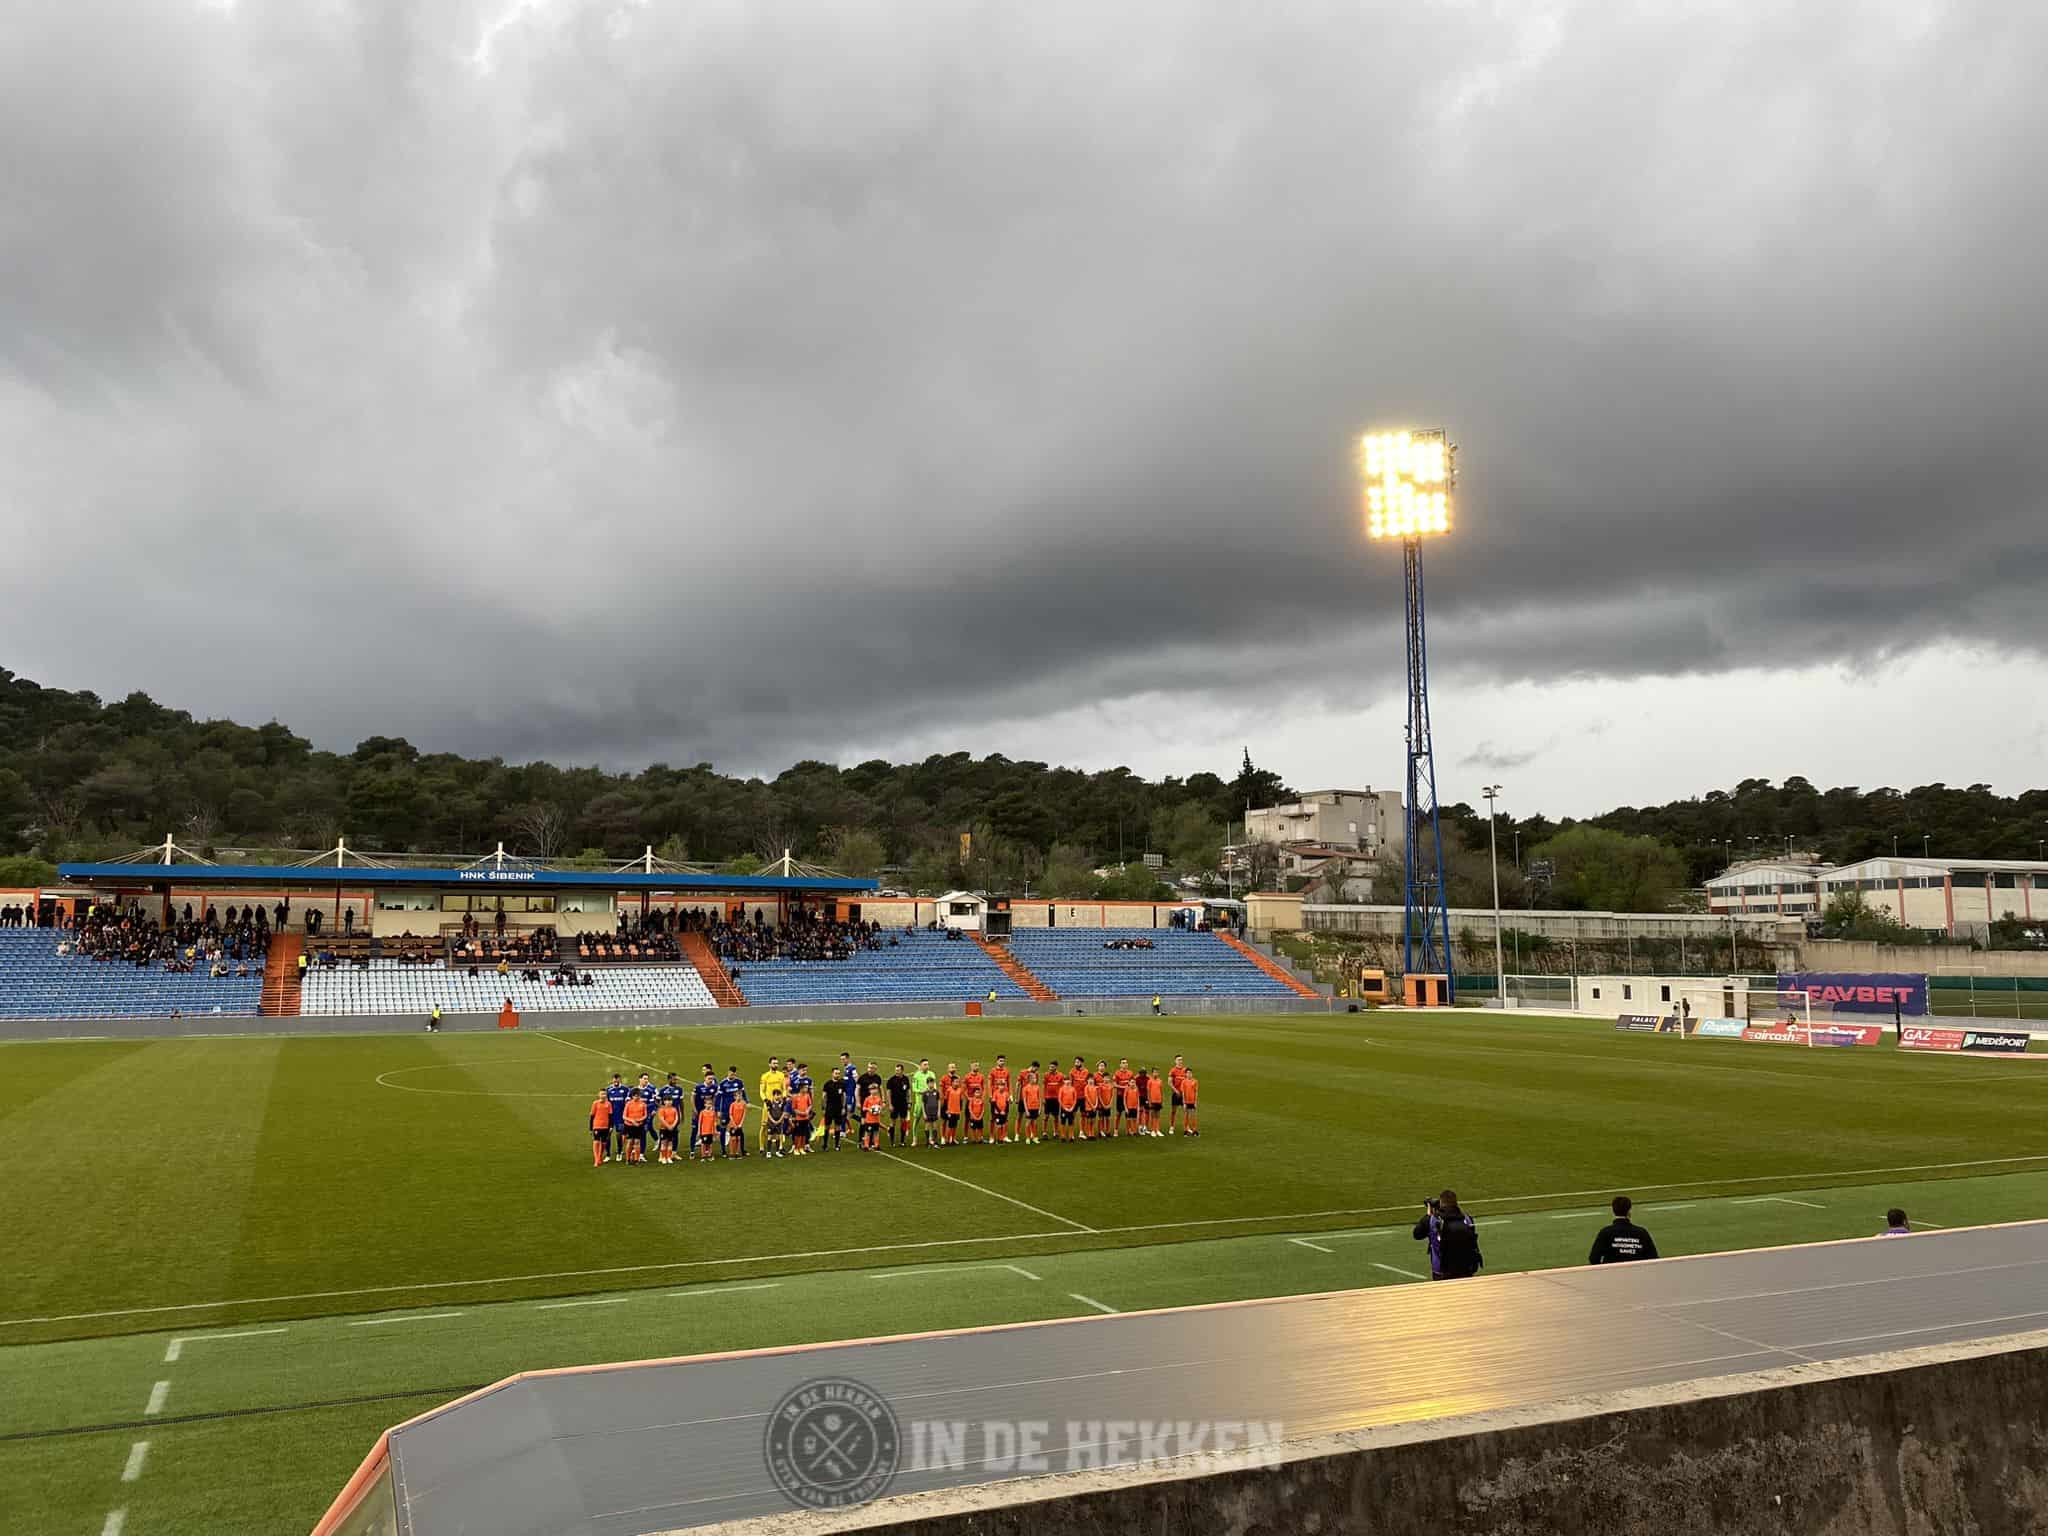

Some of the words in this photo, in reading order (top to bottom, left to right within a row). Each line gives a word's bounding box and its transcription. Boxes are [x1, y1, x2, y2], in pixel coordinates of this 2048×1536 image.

[460, 871, 486, 880] HNK
[488, 871, 535, 880] ŠIBENIK
[1806, 985, 1914, 1003] FAVBET
[1754, 1030, 1796, 1042] aircash
[1903, 1029, 1932, 1041] GAZ
[1975, 1036, 2028, 1048] MEDIŠPORT
